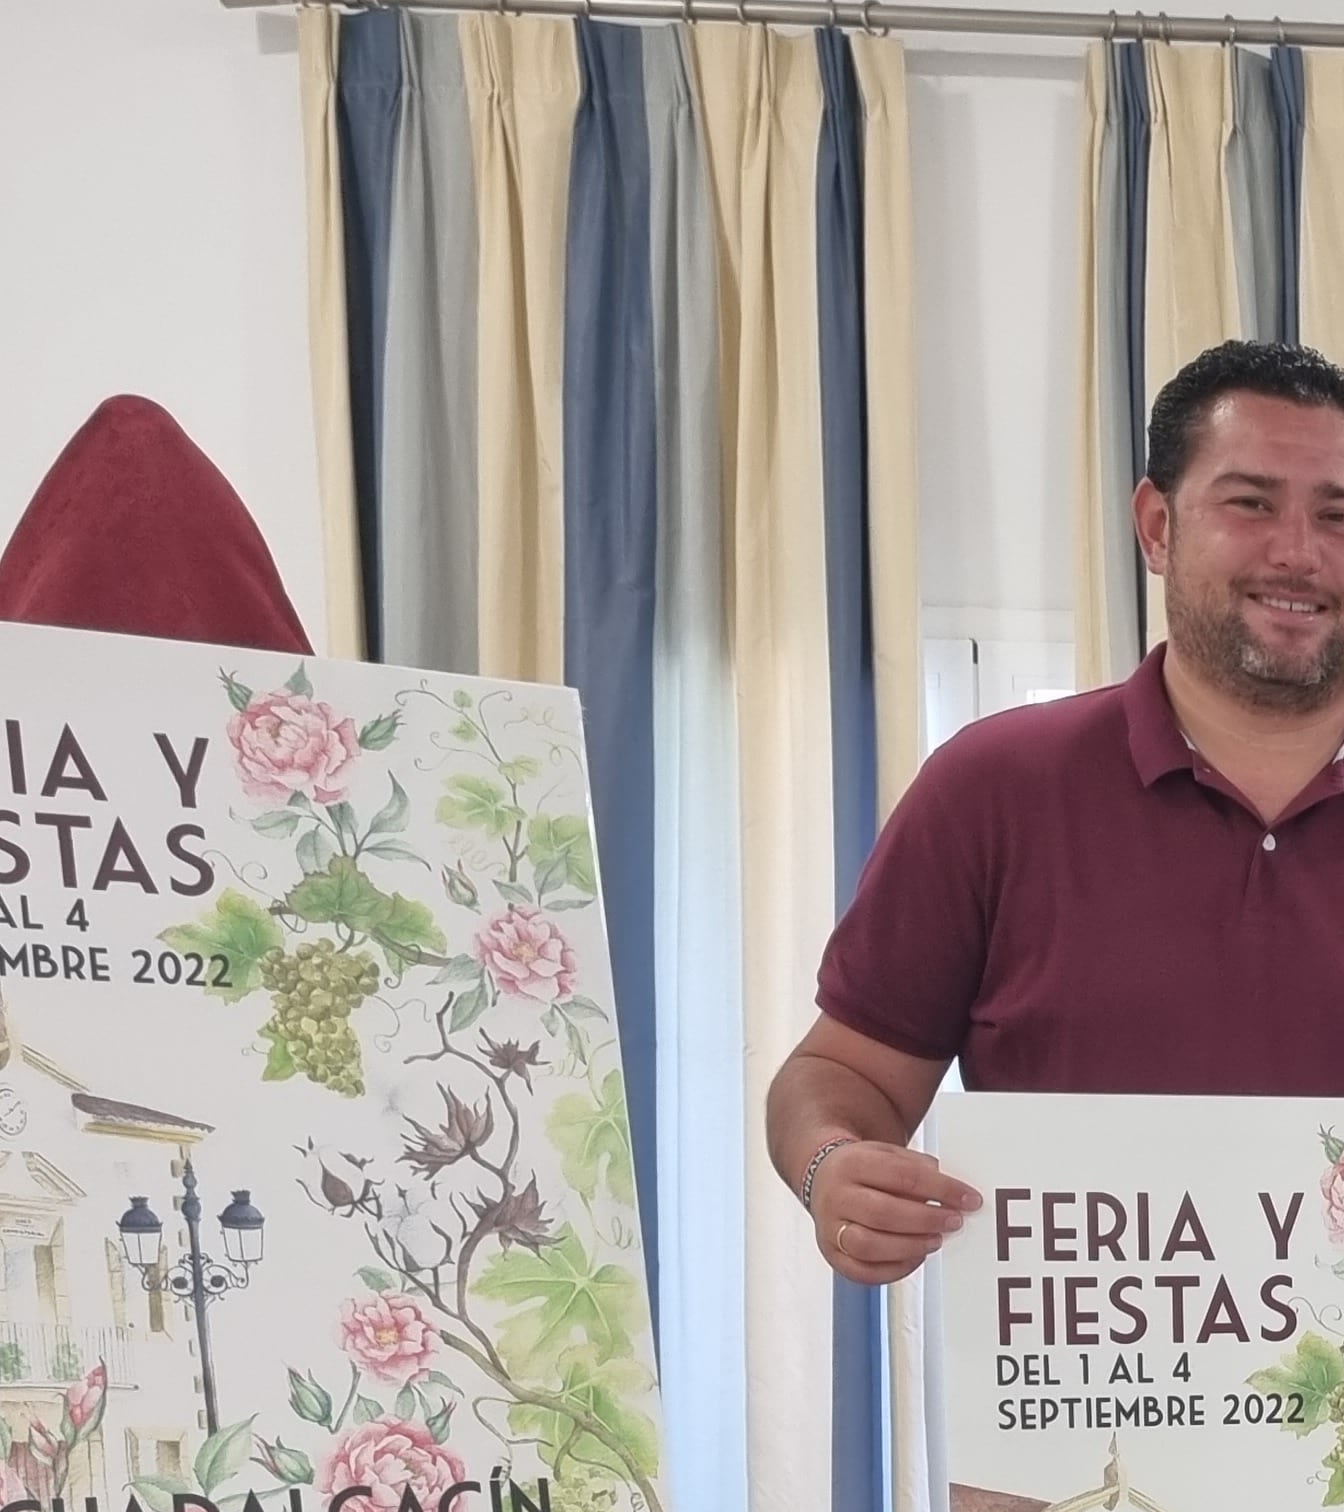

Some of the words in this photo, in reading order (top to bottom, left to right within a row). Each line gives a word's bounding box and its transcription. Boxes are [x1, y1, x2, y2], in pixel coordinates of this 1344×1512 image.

[153, 733, 209, 809] Y
[66, 898, 90, 932] 4
[131, 949, 233, 988] 2022
[995, 1188, 1216, 1262] FERIA
[1258, 1192, 1305, 1260] Y
[997, 1274, 1297, 1346] FIESTAS
[996, 1354, 1061, 1386] DEL
[1079, 1353, 1089, 1385] 1
[1108, 1352, 1154, 1384] AL
[1172, 1351, 1191, 1383] 4
[998, 1395, 1205, 1430] SEPTIEMBRE
[1222, 1392, 1305, 1425] 2022
